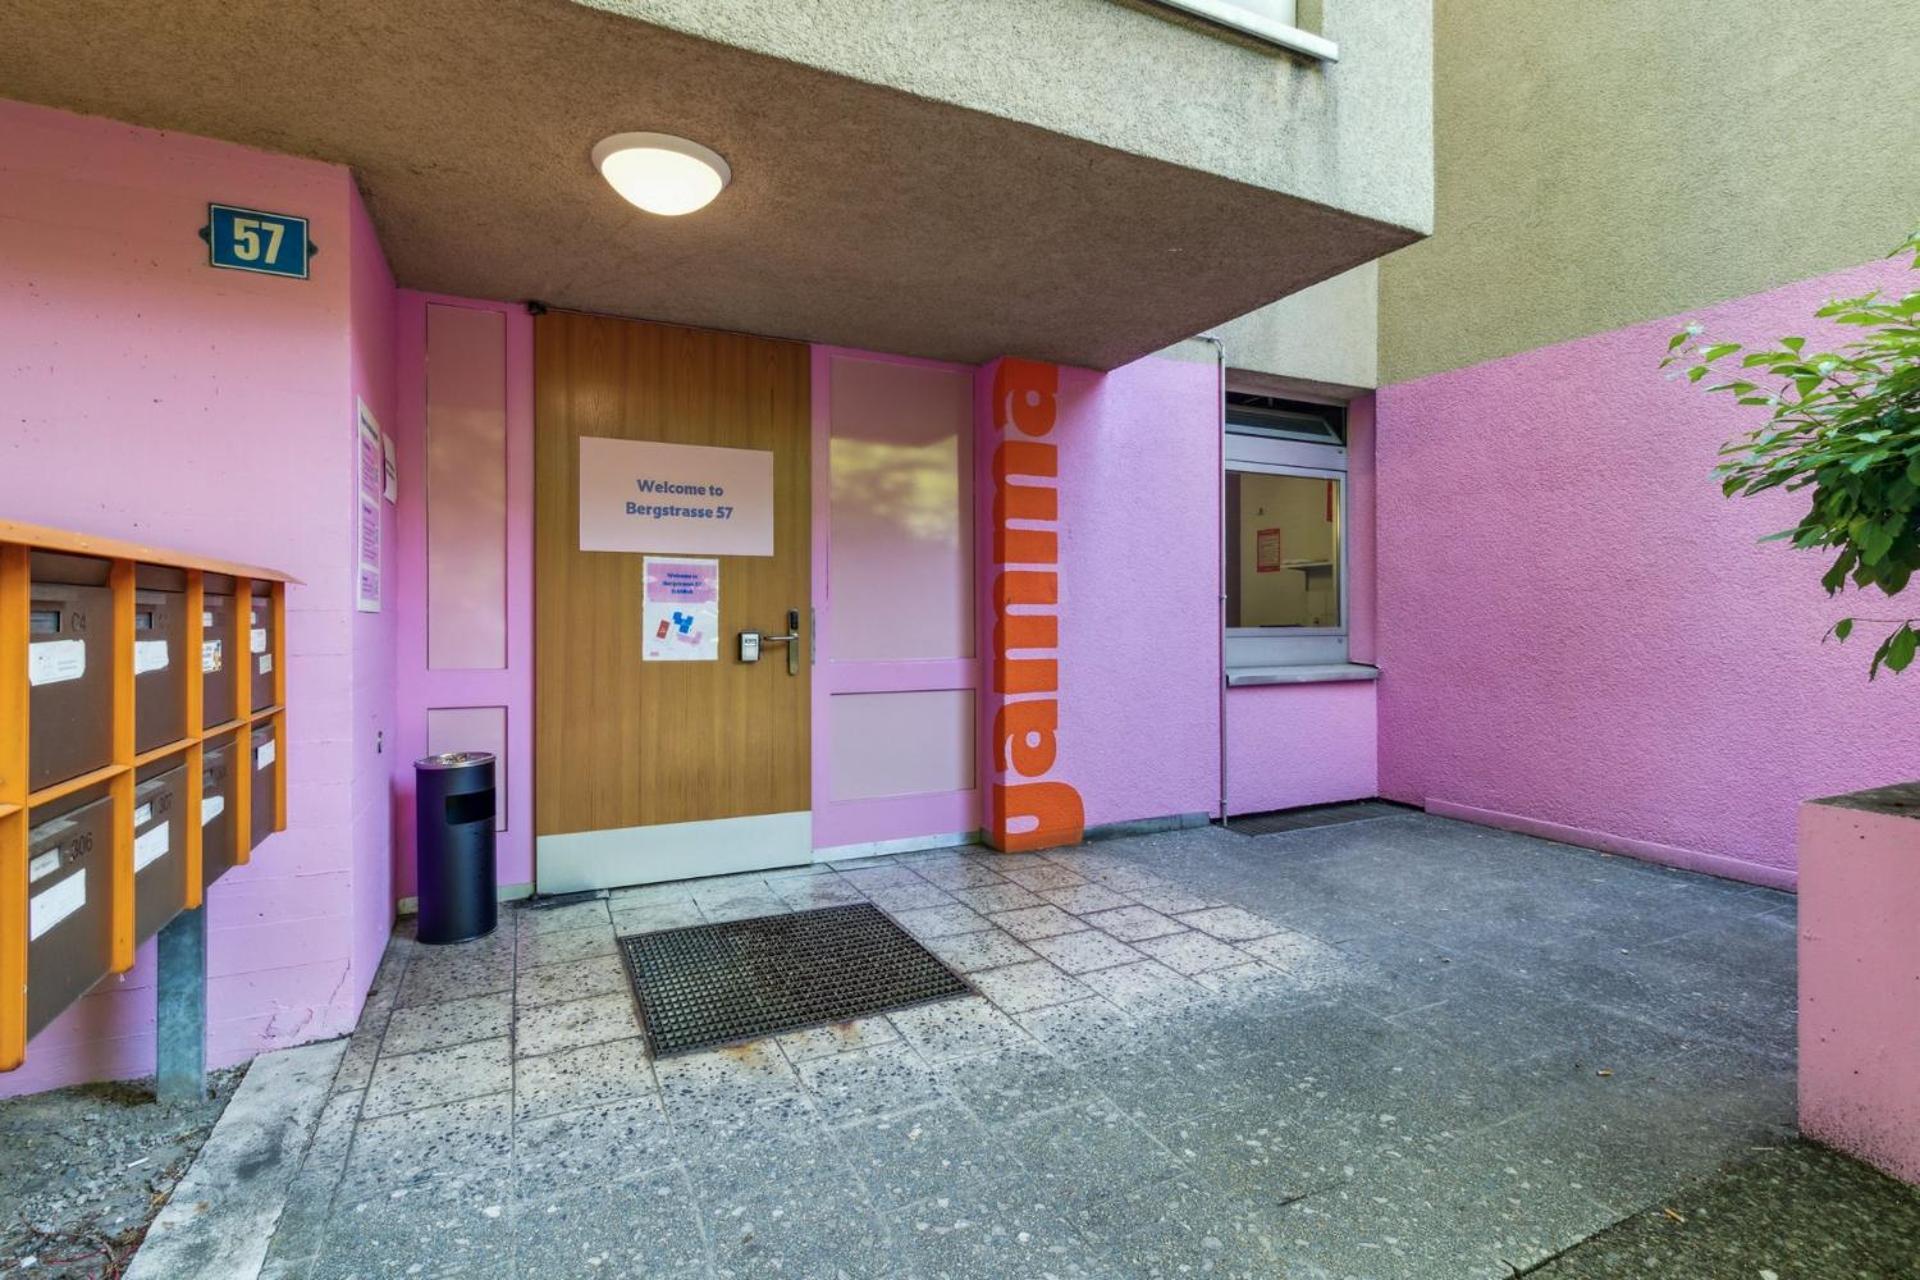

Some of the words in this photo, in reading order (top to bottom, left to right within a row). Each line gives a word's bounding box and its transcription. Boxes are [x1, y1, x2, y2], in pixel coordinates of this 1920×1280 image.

[232, 217, 286, 266] 57
[637, 478, 706, 496] Welcome
[708, 483, 724, 497] to
[626, 501, 713, 519] Bergstrasse
[715, 506, 734, 520] 57
[71, 831, 93, 860] 306
